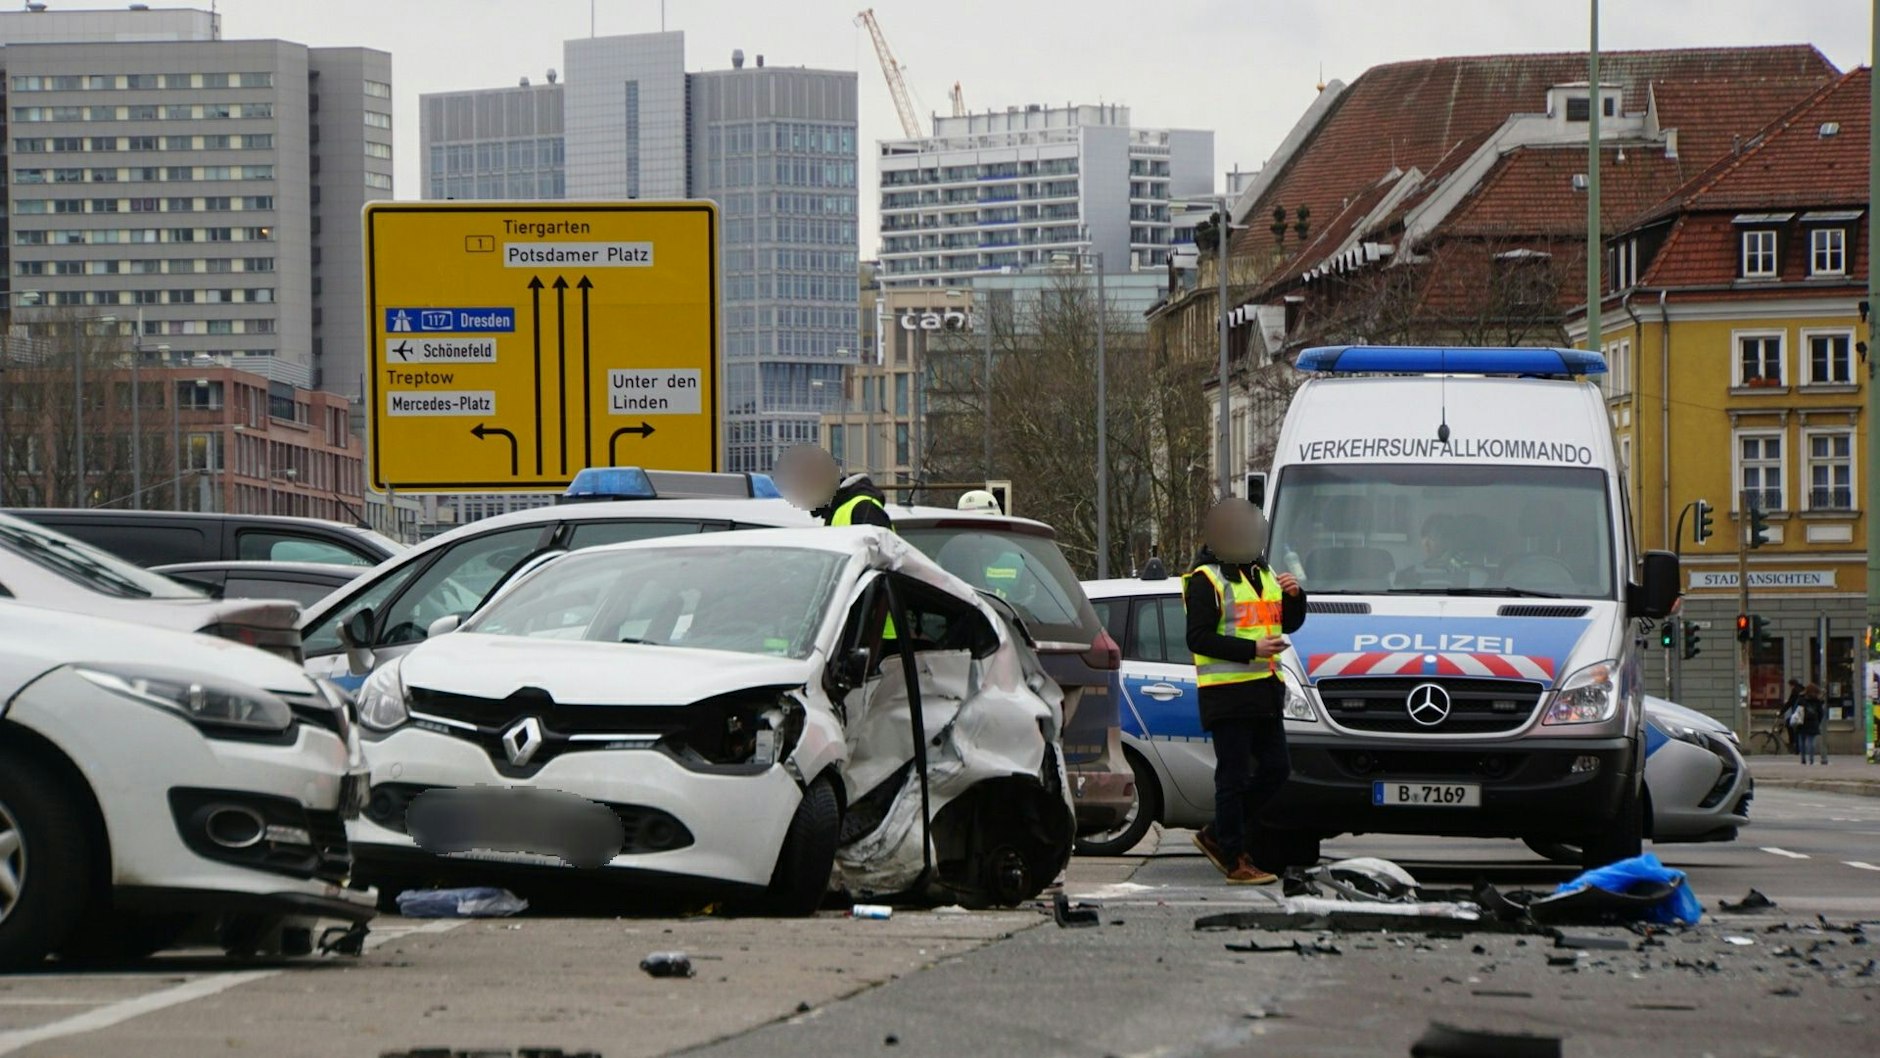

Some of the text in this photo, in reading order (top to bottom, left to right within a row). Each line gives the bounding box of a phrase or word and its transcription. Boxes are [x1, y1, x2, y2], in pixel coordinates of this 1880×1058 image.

[503, 220, 590, 238] Tiergarten
[508, 246, 649, 262] Potsdamer Platz
[427, 313, 510, 328] 117 Dresden
[423, 344, 491, 358] Schönefeld
[387, 370, 454, 387] Treptow
[613, 373, 697, 389] Unter den
[392, 396, 490, 411] Mercedes-Platz
[613, 395, 668, 410] Linden
[1299, 438, 1592, 465] VERKEHRSUNFALLKOMMANDO
[1704, 573, 1821, 585] STADANSICHTEN
[1353, 634, 1514, 655] POLIZEI
[1398, 785, 1410, 802] B
[1422, 786, 1466, 804] 7169
